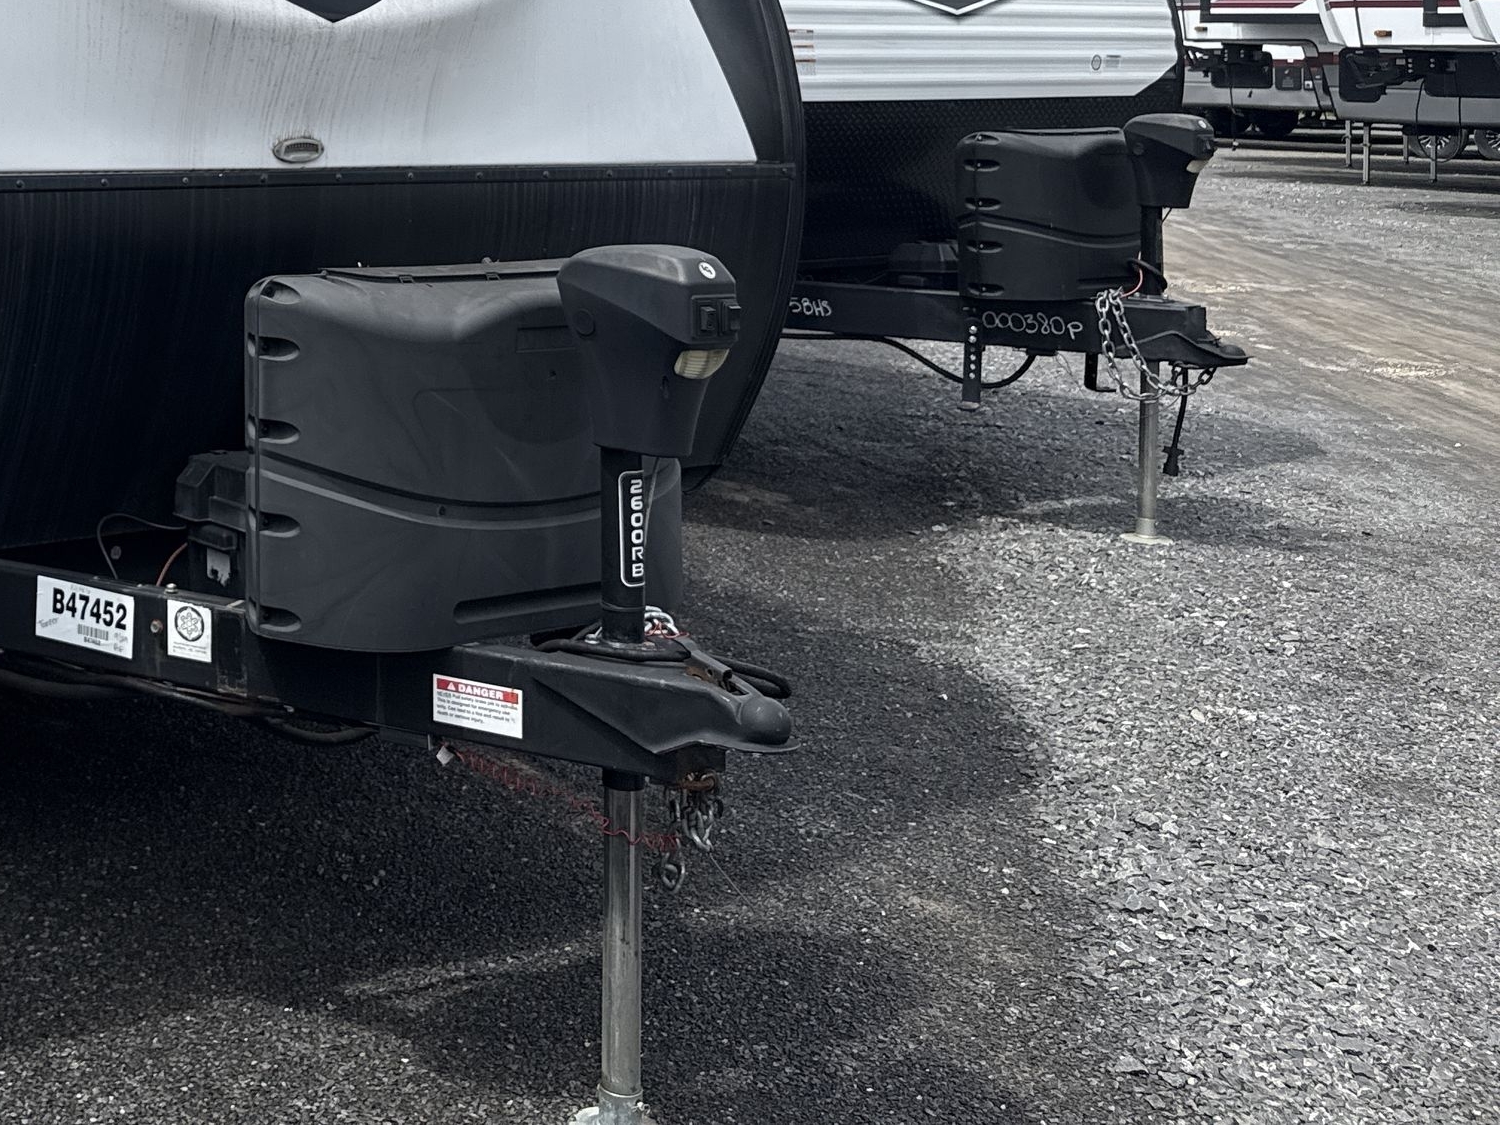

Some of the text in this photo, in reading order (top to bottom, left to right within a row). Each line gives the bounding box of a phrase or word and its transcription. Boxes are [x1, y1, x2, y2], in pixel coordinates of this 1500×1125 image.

[630, 479, 644, 577] 2600RB
[52, 587, 127, 630] B47452
[458, 683, 504, 700] DANGER
